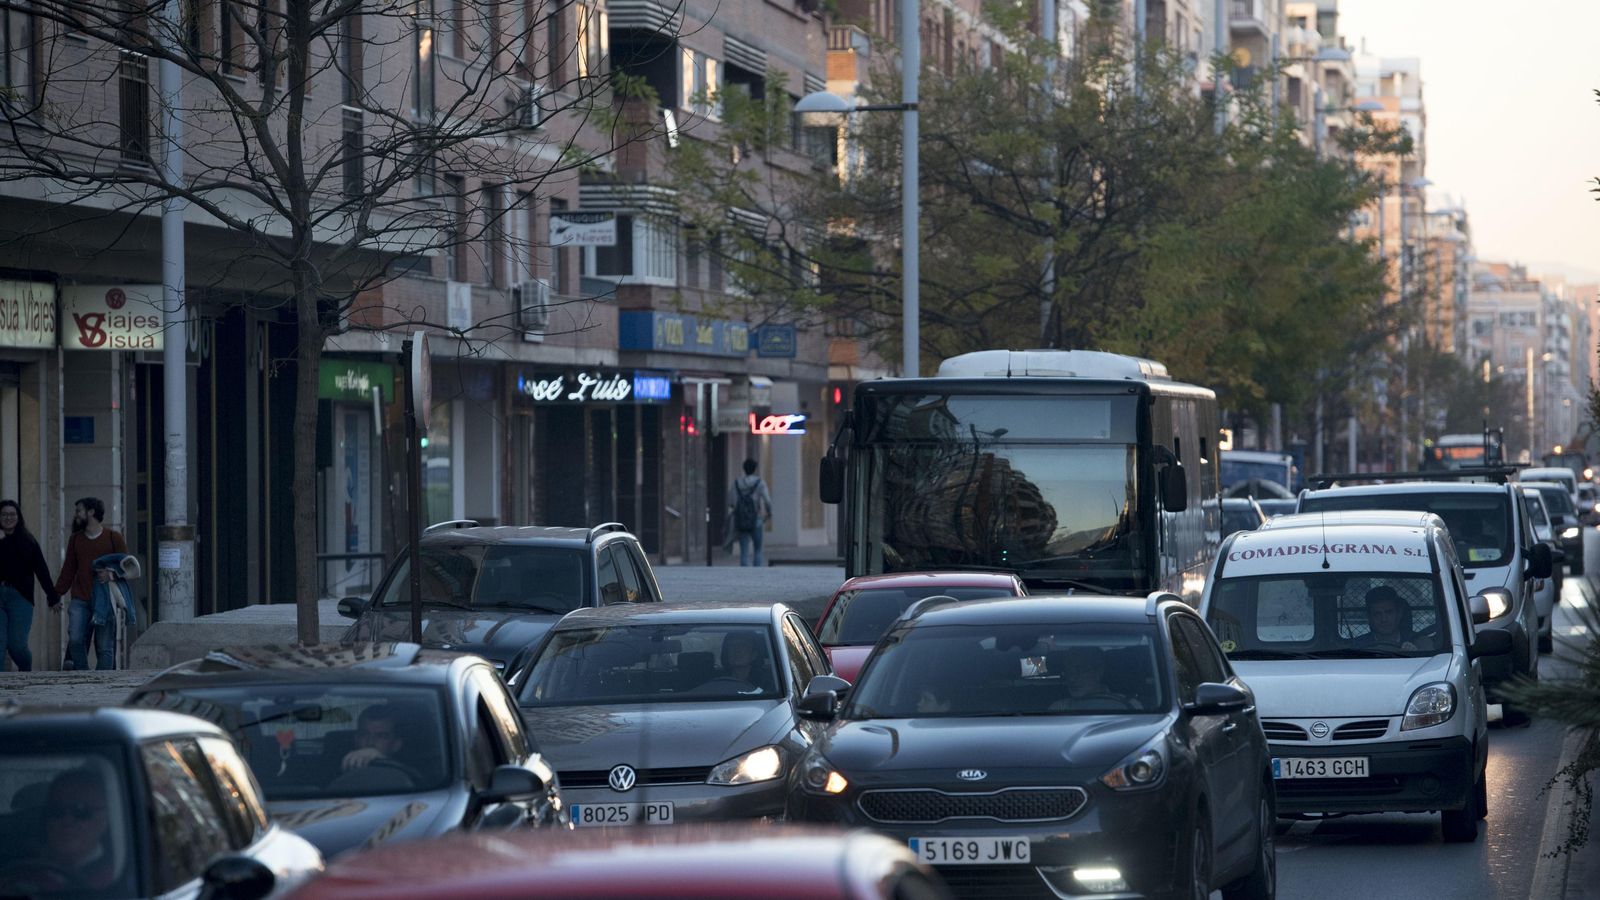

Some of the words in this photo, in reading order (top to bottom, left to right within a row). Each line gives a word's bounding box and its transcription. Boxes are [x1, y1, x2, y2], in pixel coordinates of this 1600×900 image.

[22, 288, 55, 343] Viajes
[568, 372, 632, 402] Luis
[1228, 543, 1397, 562] COMADISAGRANA
[1286, 760, 1327, 776] 1463
[1332, 759, 1365, 776] GCH
[583, 806, 629, 823] 8025
[925, 841, 980, 861] 5169
[987, 840, 1028, 860] JWC
